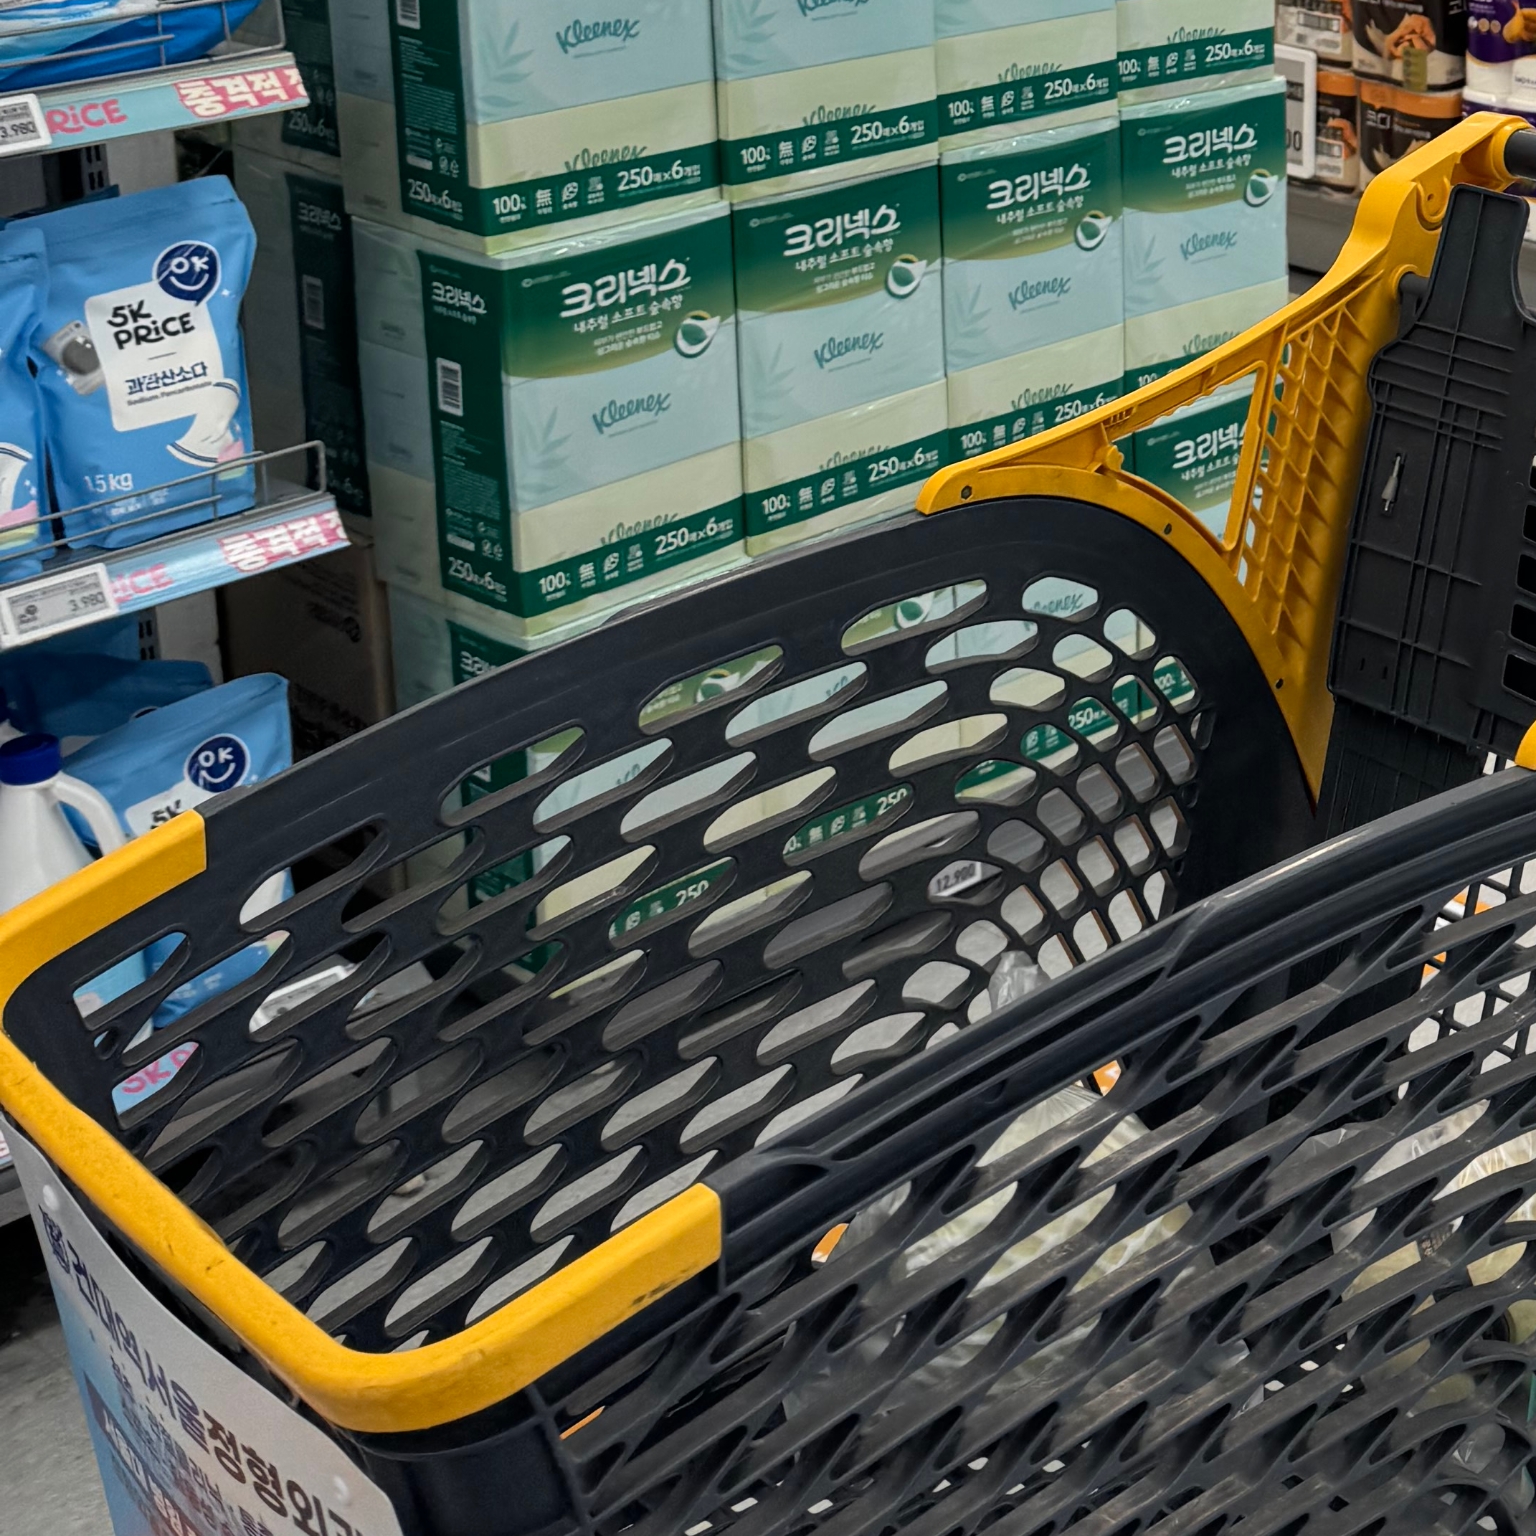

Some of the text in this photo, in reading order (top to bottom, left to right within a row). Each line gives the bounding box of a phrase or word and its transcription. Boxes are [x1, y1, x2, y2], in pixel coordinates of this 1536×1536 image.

[556, 18, 641, 54] Kleenex
[179, 71, 289, 116] 충격적
[1365, 109, 1390, 130] 코디
[1162, 124, 1258, 164] 크리넥스
[986, 163, 1091, 210] 크리넥스
[783, 204, 901, 257] 크리넥스
[863, 238, 894, 257] 숲속향
[1180, 231, 1238, 260] Kleenex
[171, 255, 209, 273] OK
[560, 258, 691, 318] 크리넥스
[1008, 277, 1071, 311] Kleenex
[107, 300, 152, 328] 5K
[574, 295, 683, 334] 내추럴 소프트 숲속향
[815, 331, 884, 368] Kleenex
[126, 361, 209, 396] 과탄산소다
[592, 393, 672, 435] Kleenex
[219, 516, 328, 573] 충격적
[199, 747, 234, 767] OK
